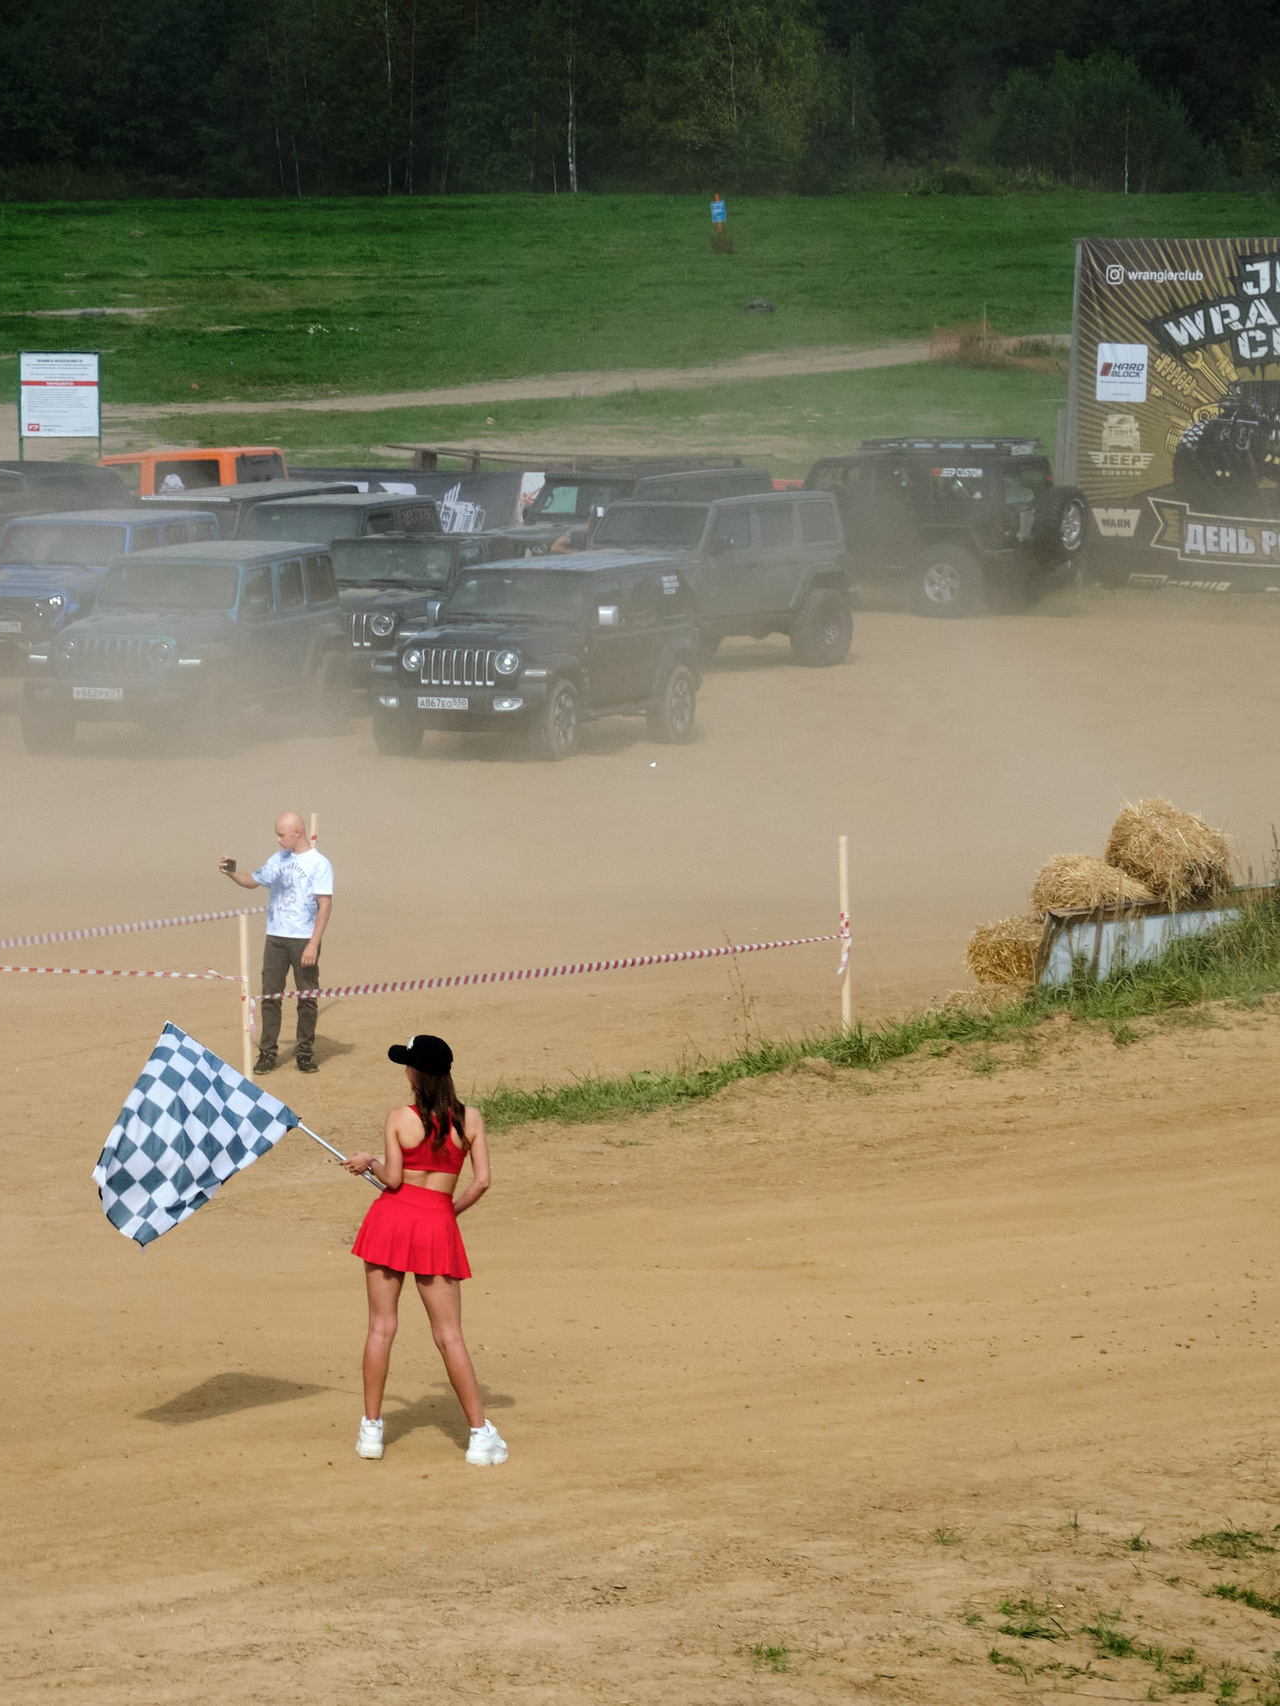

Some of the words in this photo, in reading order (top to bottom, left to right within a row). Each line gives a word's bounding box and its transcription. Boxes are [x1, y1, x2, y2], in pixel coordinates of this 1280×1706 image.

[1128, 269, 1204, 284] wranglerclub
[1113, 362, 1145, 371] HARD
[1110, 370, 1141, 378] BLOCK
[1100, 454, 1142, 466] JEEP
[941, 467, 955, 477] JEEP
[1101, 469, 1141, 477] CUSTOM
[1101, 518, 1131, 529] WARN
[1185, 523, 1255, 555] ДЕНЬ
